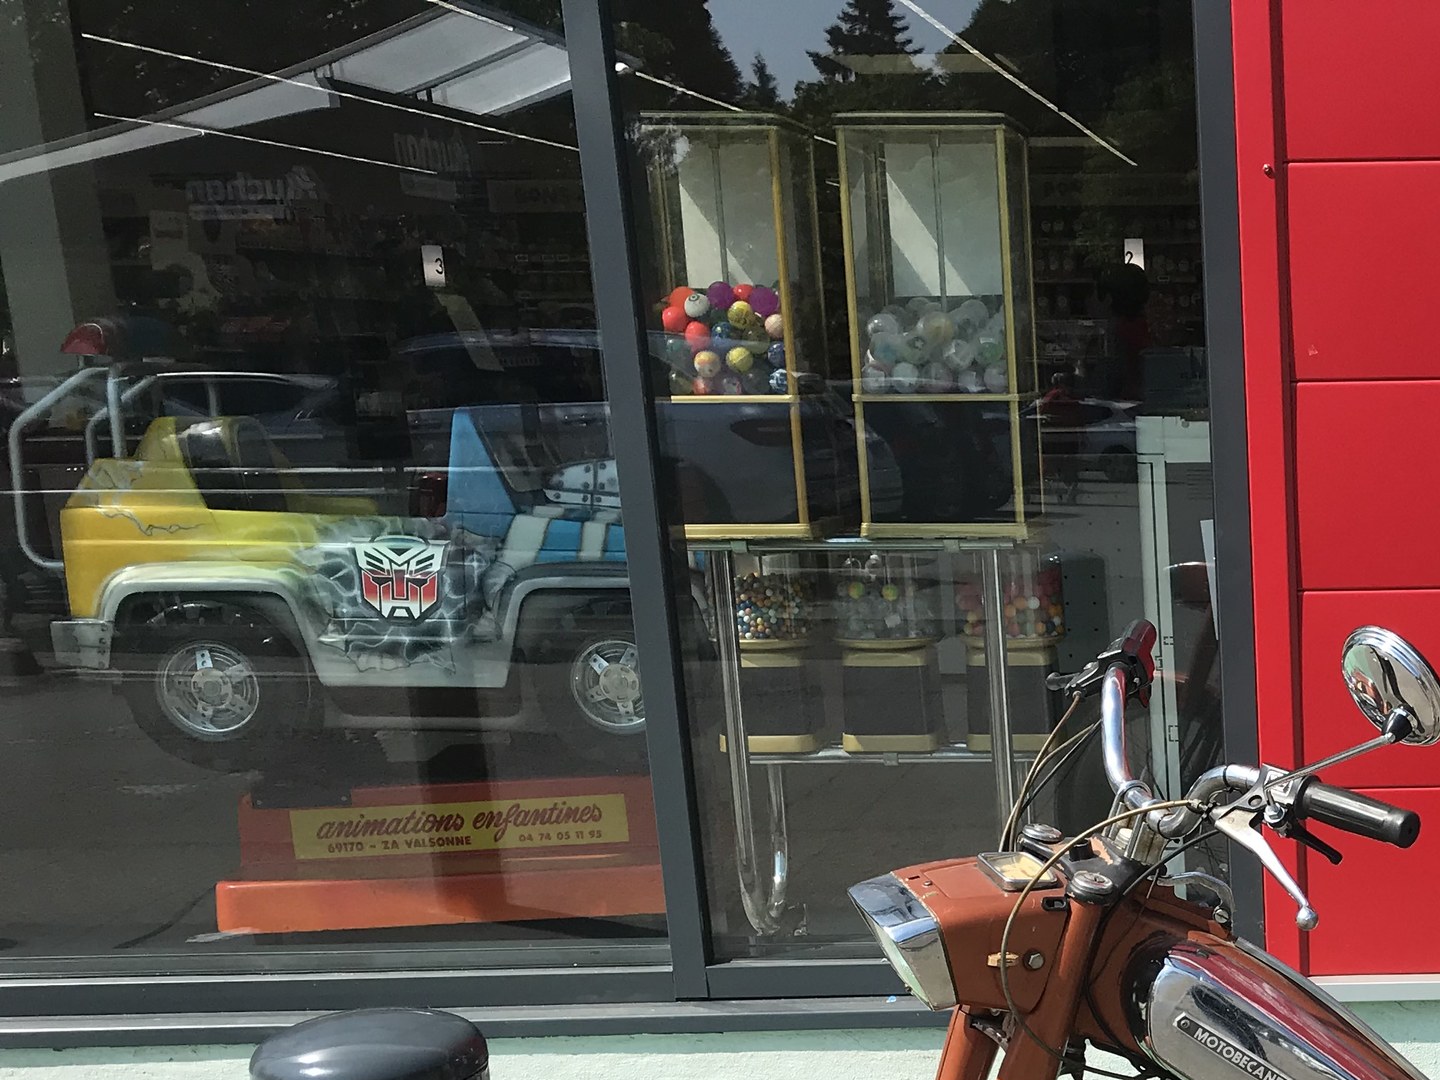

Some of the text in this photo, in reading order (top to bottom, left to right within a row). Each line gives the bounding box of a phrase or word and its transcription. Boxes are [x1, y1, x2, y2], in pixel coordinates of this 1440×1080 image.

[434, 257, 444, 275] 3
[316, 801, 603, 842] animations enfantines
[327, 841, 365, 853] 69170
[381, 840, 400, 850] ZA
[404, 835, 472, 849] VALSONNE
[556, 831, 570, 840] 05
